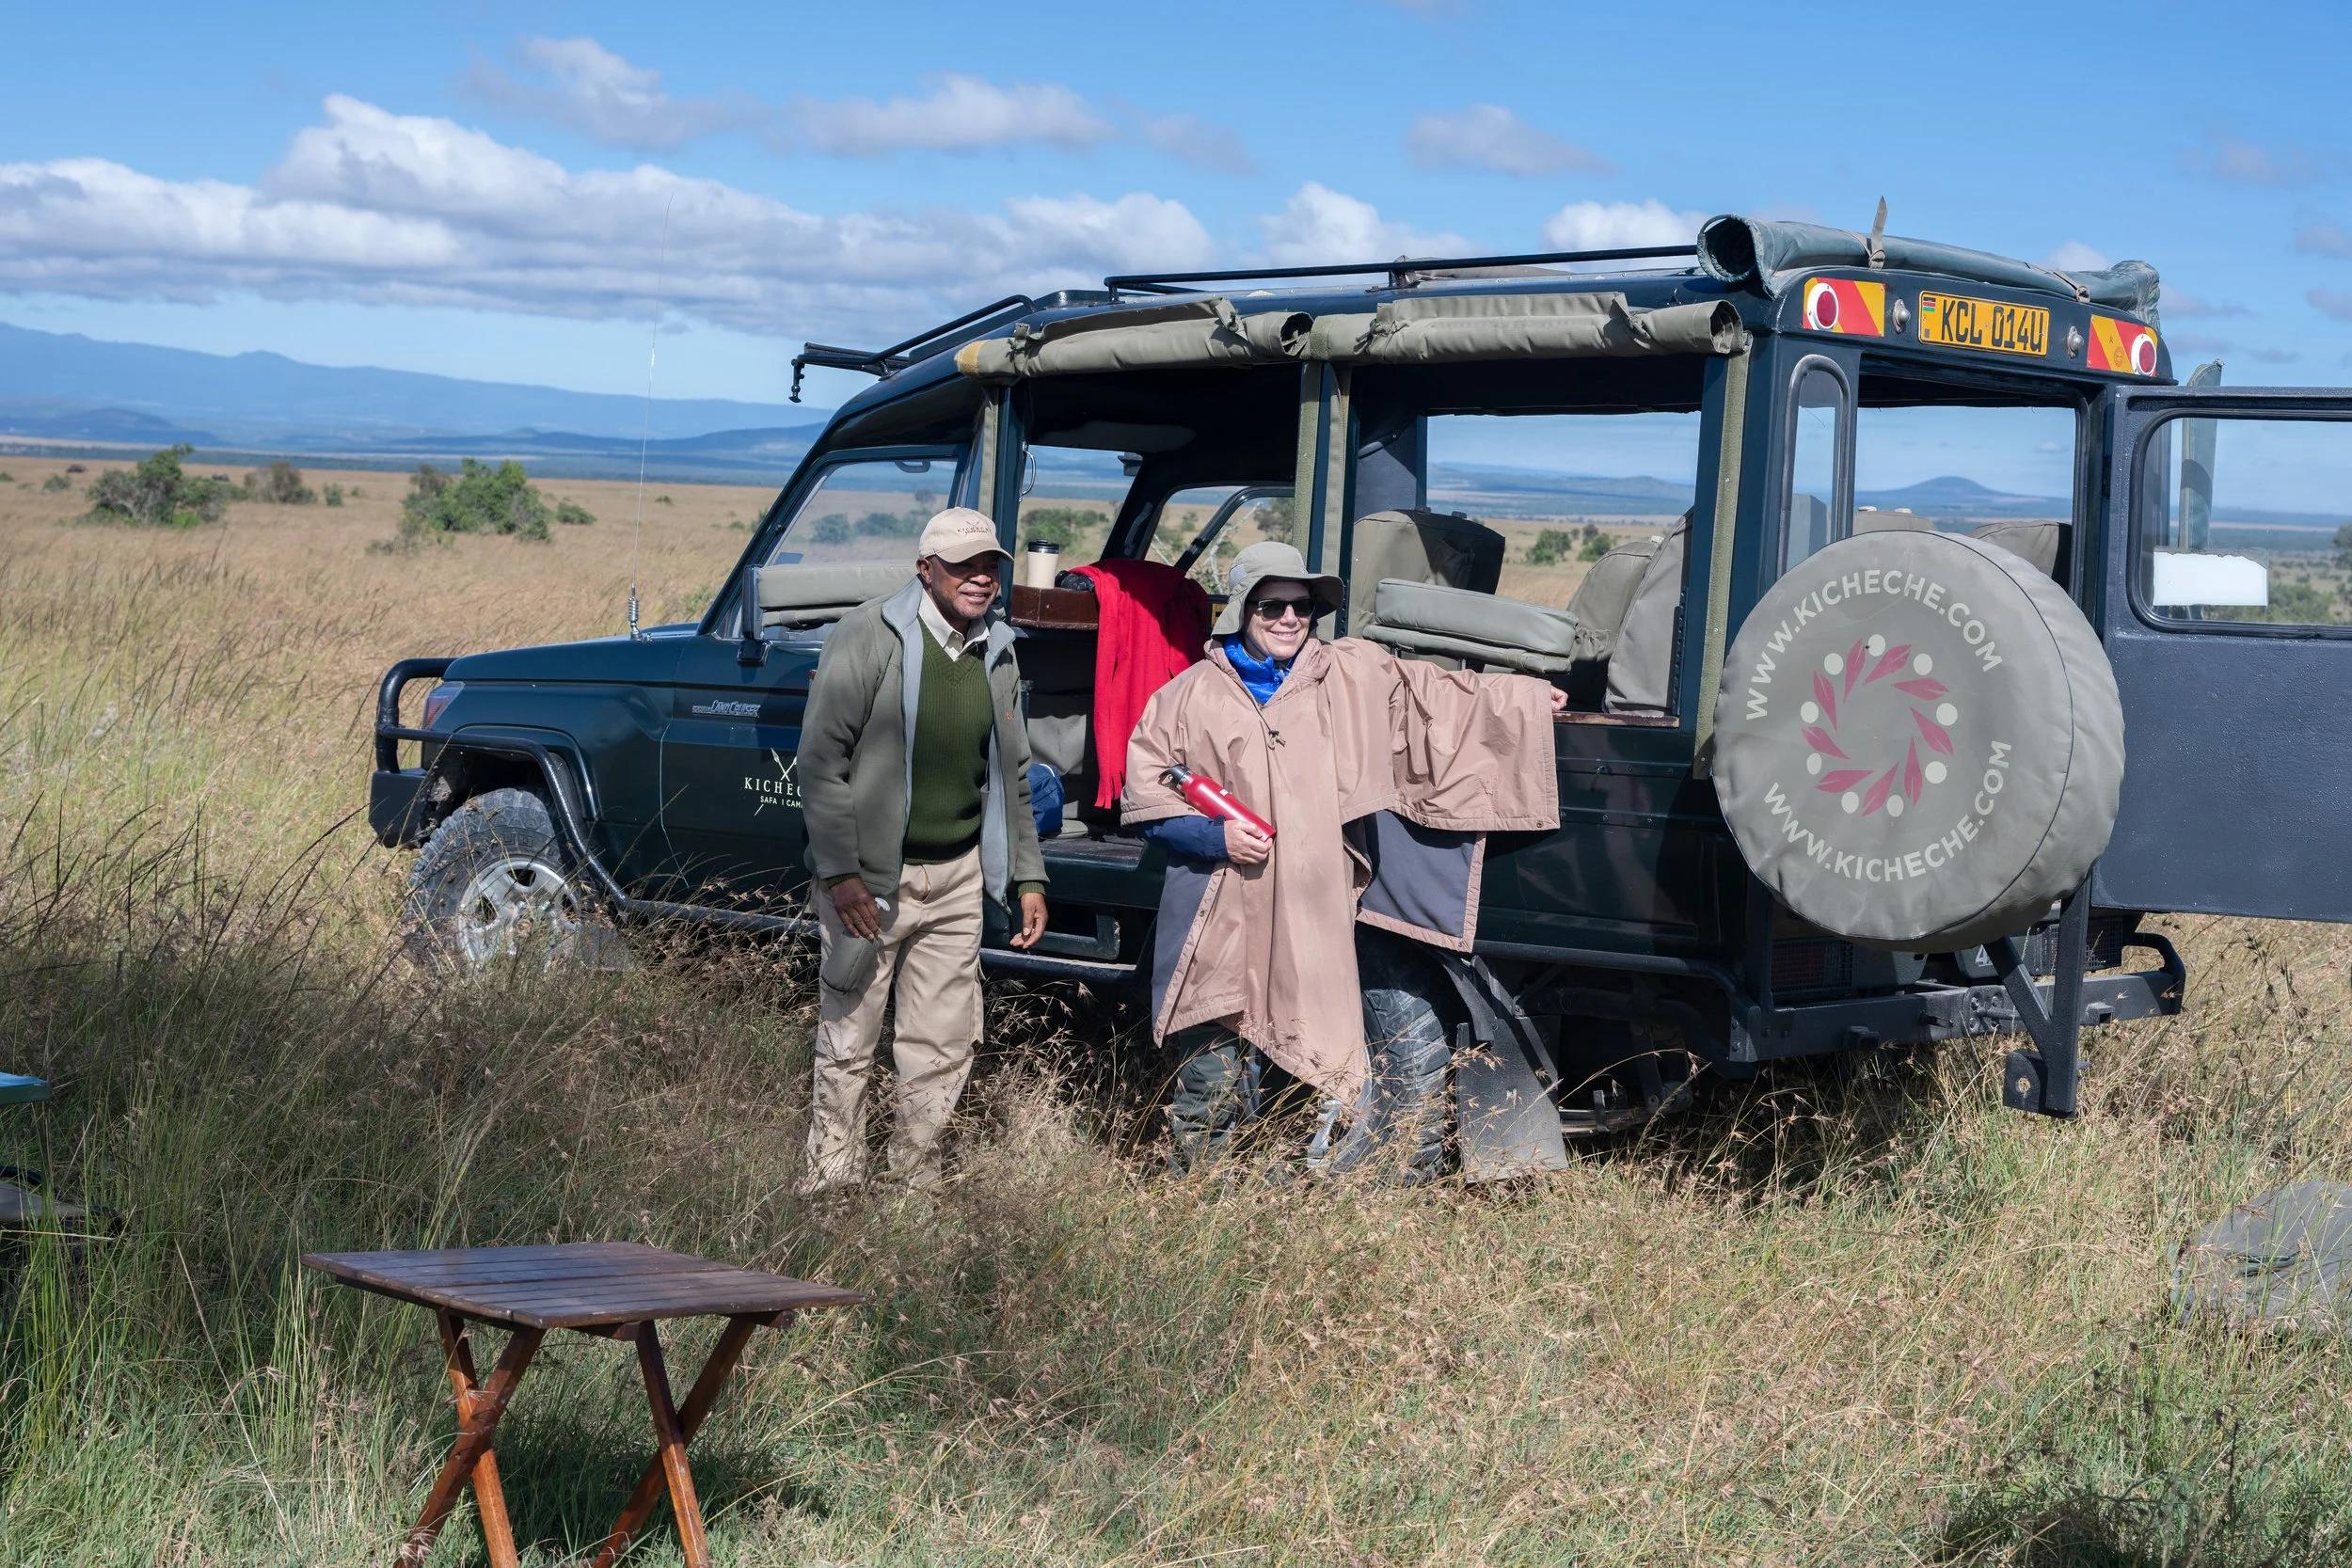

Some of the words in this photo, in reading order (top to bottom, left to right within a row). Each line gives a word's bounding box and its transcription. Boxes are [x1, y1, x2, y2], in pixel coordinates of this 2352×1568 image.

[1942, 298, 1982, 345] KCL
[1991, 306, 2044, 353] 014U
[1745, 569, 2003, 721] WWW.KICHECHE.COM
[786, 800, 803, 809] CAM
[1763, 740, 2011, 882] WWW.KICHECHE.COM
